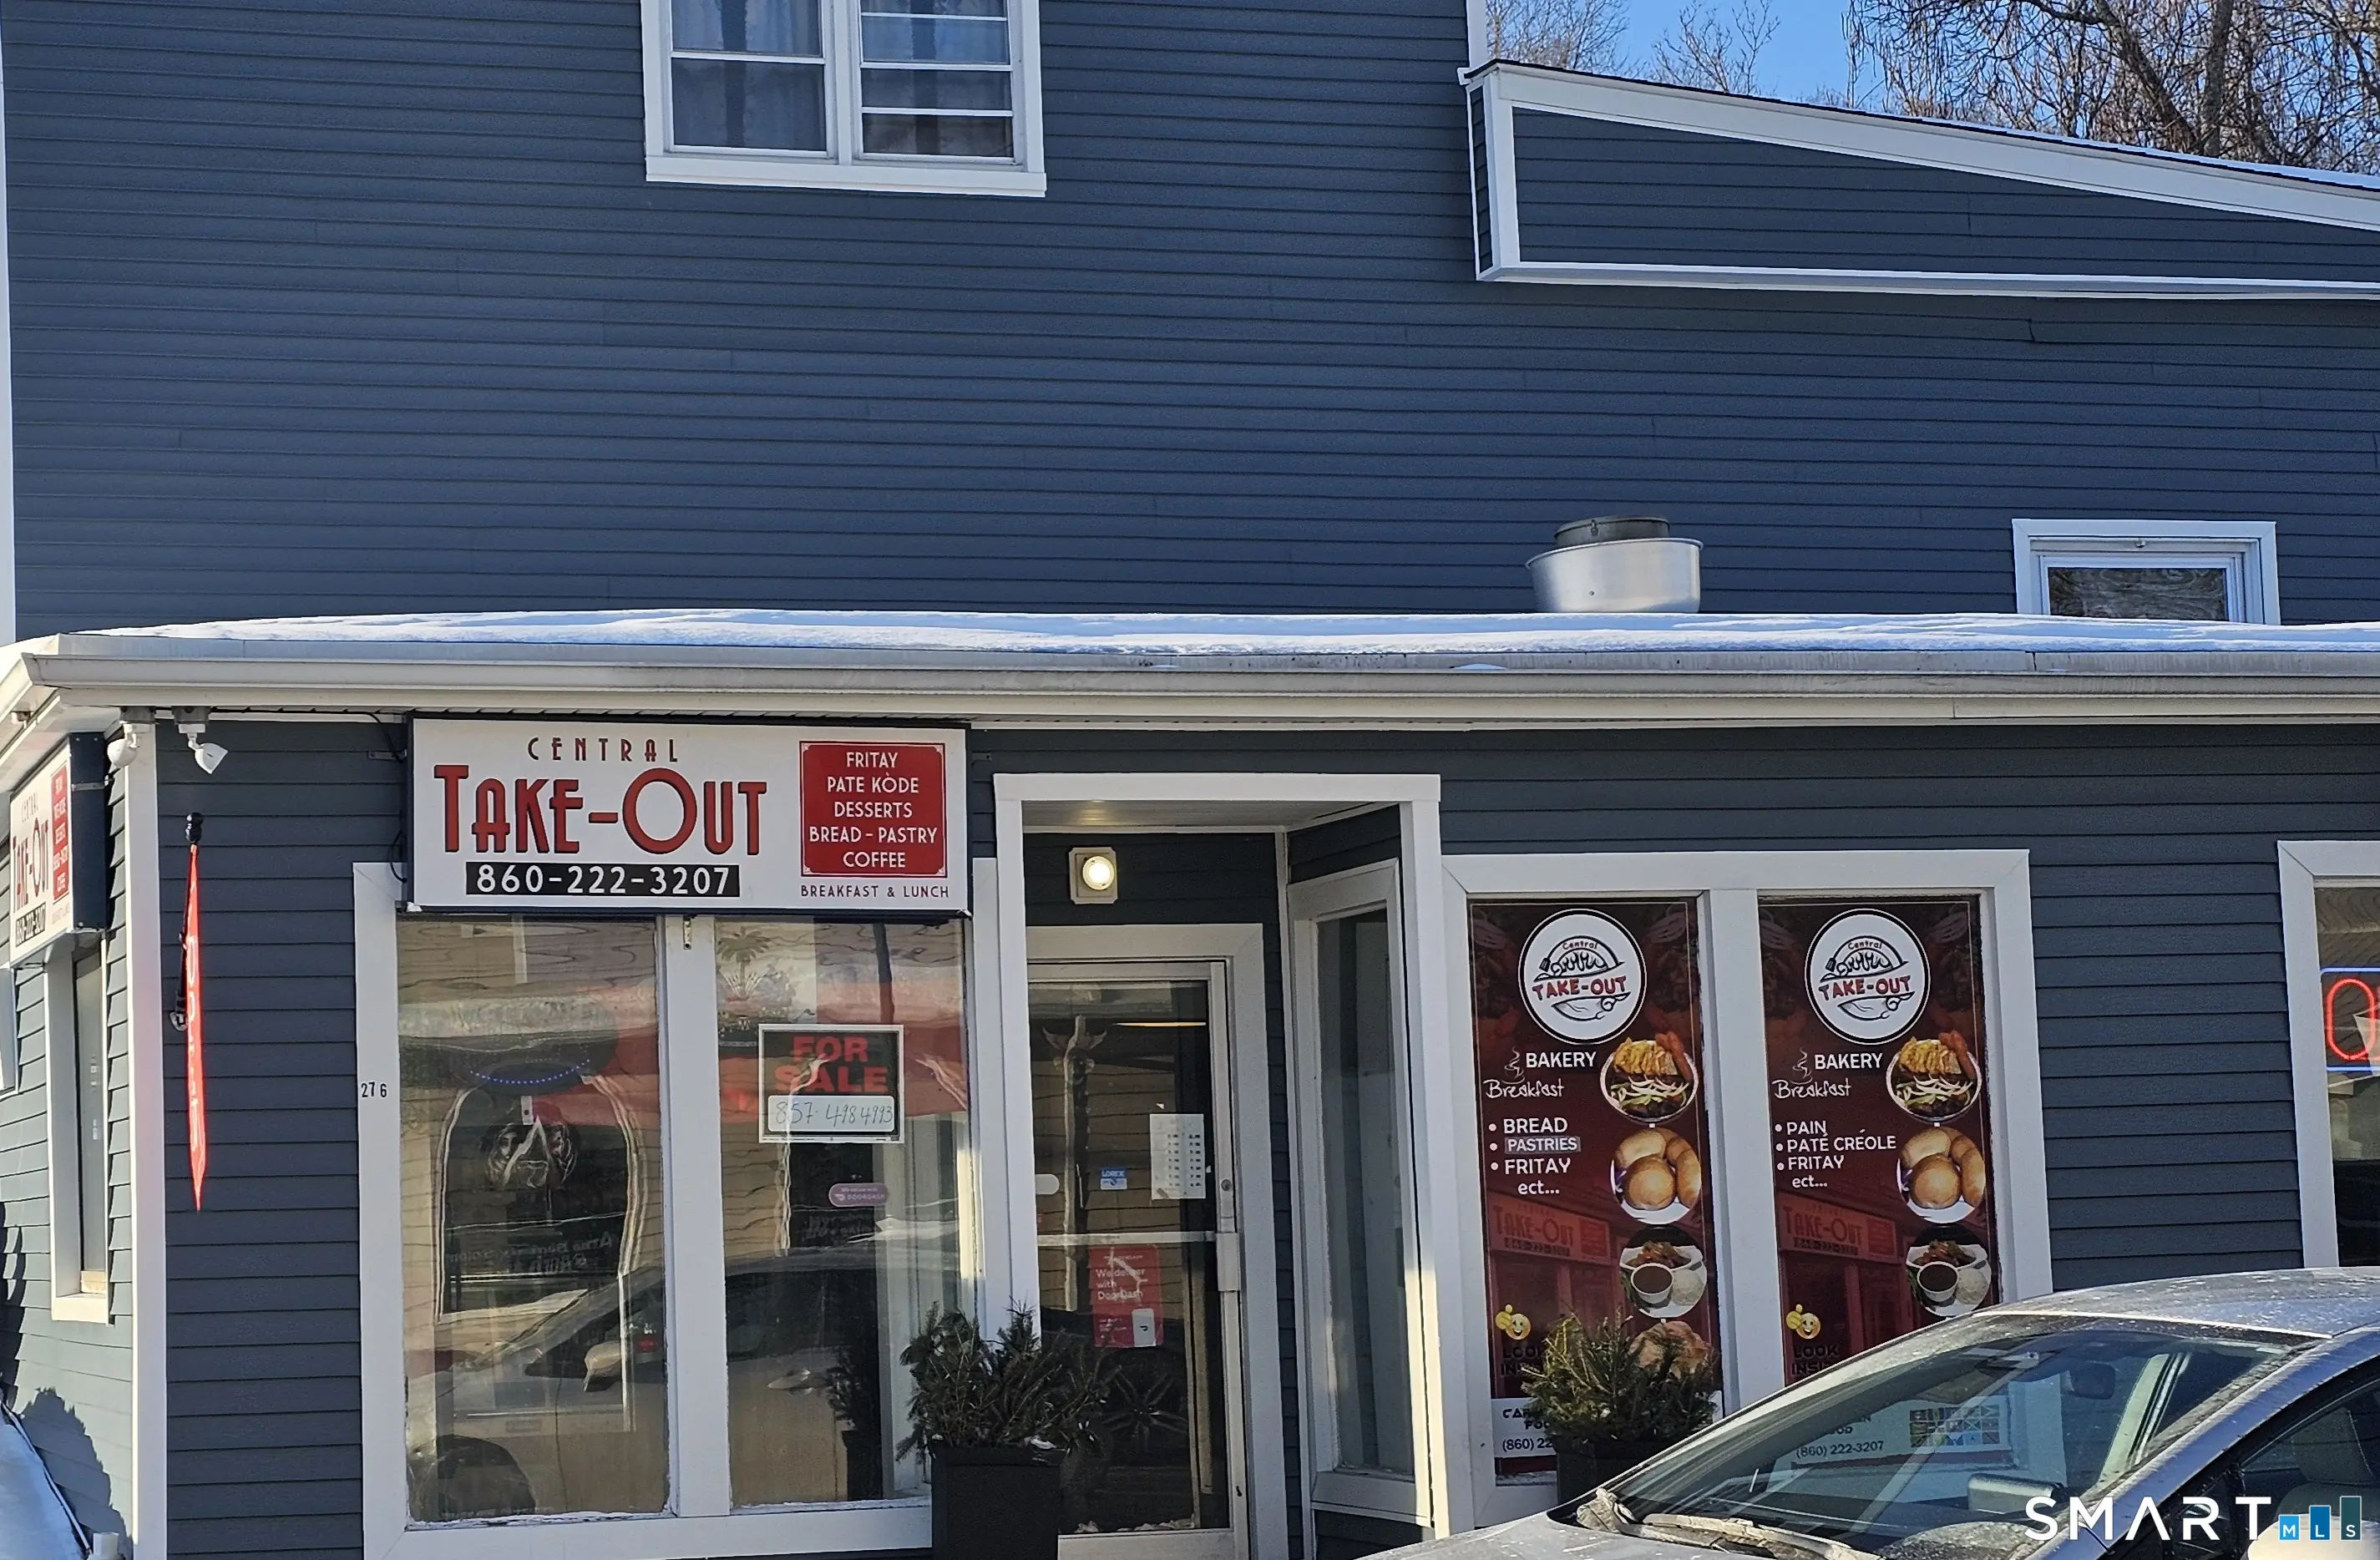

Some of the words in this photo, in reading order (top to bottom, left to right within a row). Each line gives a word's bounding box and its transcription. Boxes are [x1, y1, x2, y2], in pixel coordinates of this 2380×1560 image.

[527, 737, 678, 762] CENTRAL
[846, 752, 899, 768] FRITAY
[828, 777, 865, 793] PATE
[872, 772, 919, 793] KÒDE
[434, 764, 767, 857] TAKE-OUT
[834, 801, 913, 818] DESSERTS
[809, 826, 862, 843] BREAD
[879, 827, 938, 843] PASTRY
[843, 851, 906, 868] COFFEE
[477, 864, 727, 895] 860-222-3207
[801, 884, 879, 898] BREAKFAST
[887, 887, 895, 898] &
[904, 886, 949, 899] LUNCH
[1562, 940, 1598, 951] Central
[1847, 940, 1882, 951] Central
[1532, 975, 1627, 1000] TAKE-OUT
[1818, 975, 1912, 1000] TAKE-OUT
[792, 1036, 868, 1061] FOR
[1525, 1051, 1597, 1069] BAKERY
[1814, 1052, 1884, 1070] BAKERY
[775, 1065, 889, 1093] SALE
[361, 1081, 387, 1098] 276
[1483, 1077, 1565, 1099] Breakfast
[1771, 1077, 1851, 1100] Breakfast
[1503, 1117, 1567, 1134] BREAD
[1787, 1120, 1826, 1134] PAIN
[1506, 1137, 1577, 1152] PASTRIES
[1787, 1132, 1829, 1152] PATÉ
[1833, 1129, 1896, 1151] CRÉOLE
[1504, 1157, 1572, 1175] FRITAY
[1788, 1156, 1845, 1171] FRITAY
[1793, 1344, 1840, 1358] LOOK
[1502, 1437, 1534, 1452] (860)
[1830, 1441, 1885, 1455] 222-3207
